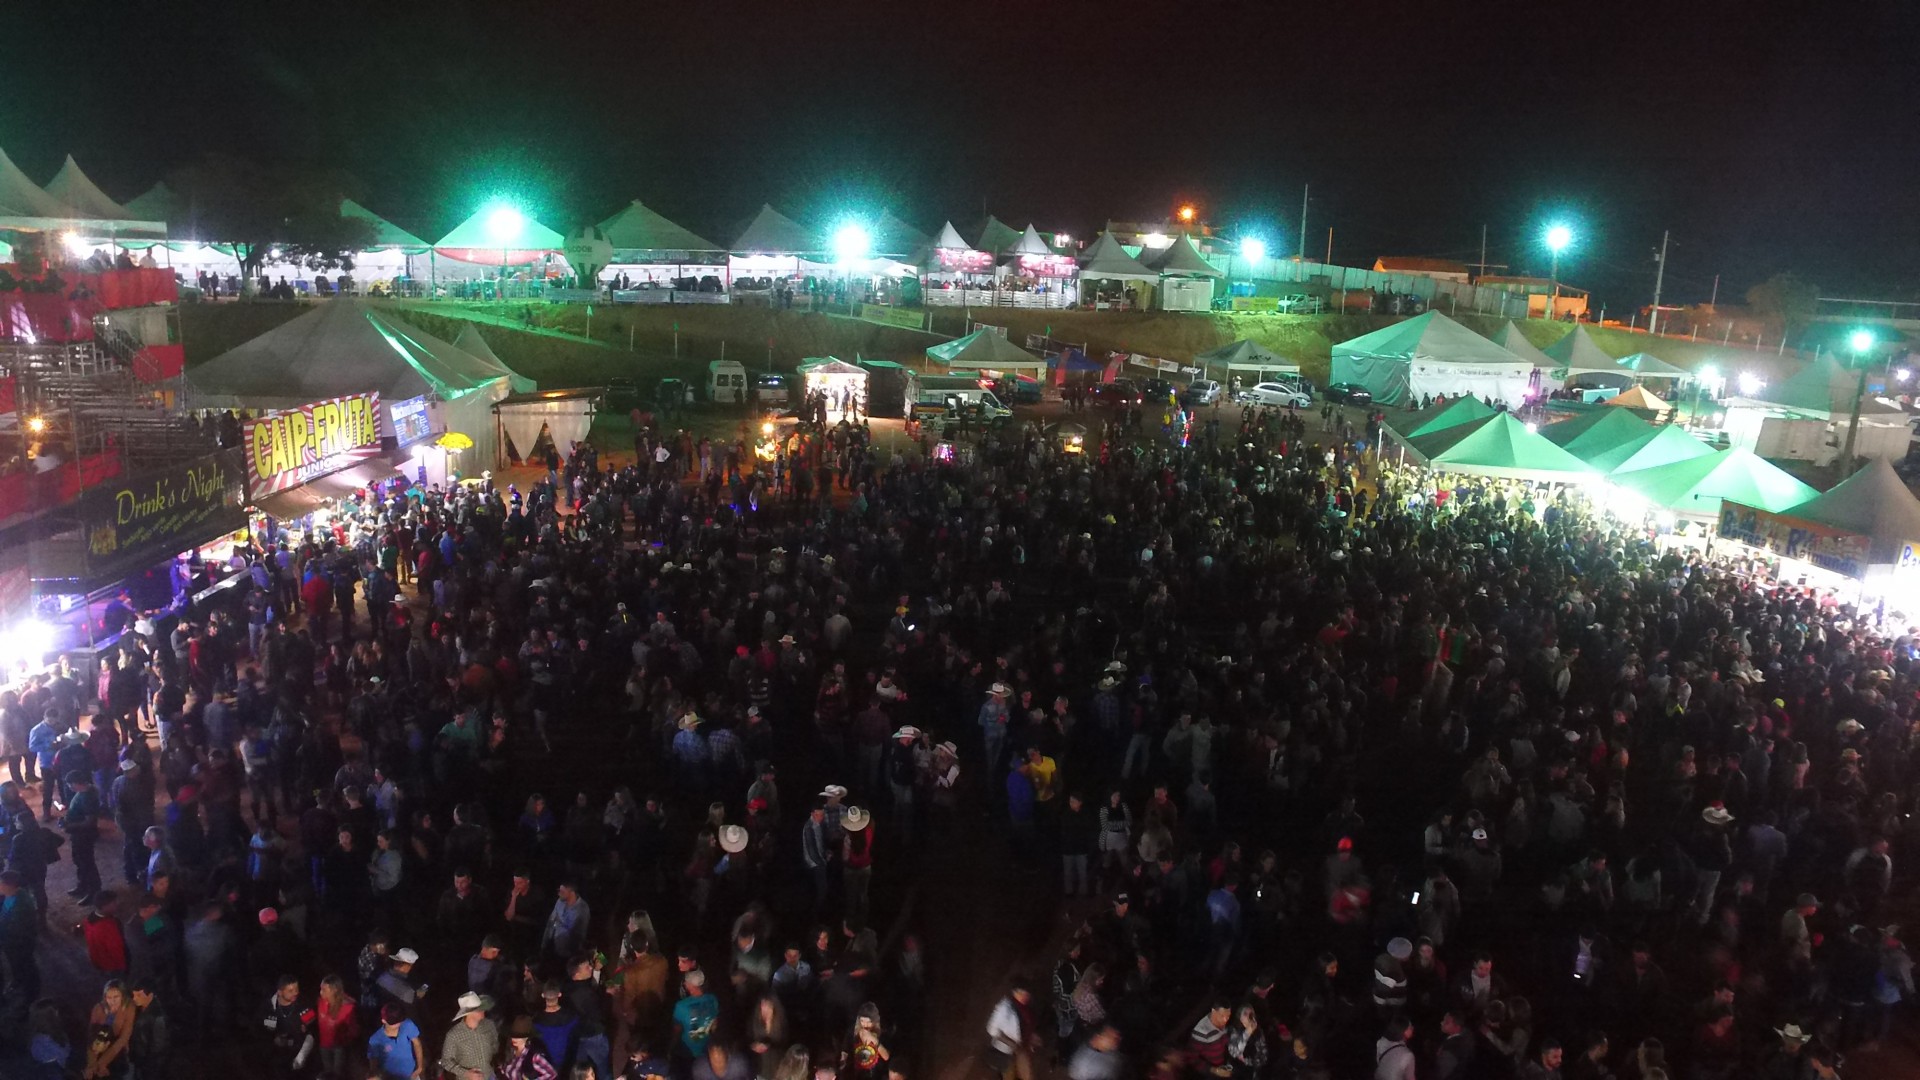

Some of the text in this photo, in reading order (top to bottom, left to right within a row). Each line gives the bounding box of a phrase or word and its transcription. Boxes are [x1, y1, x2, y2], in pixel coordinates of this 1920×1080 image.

[253, 396, 376, 480] CAIP-FRUTA
[115, 477, 175, 526] Drink's
[181, 463, 225, 503] Night
[1902, 544, 1920, 567] Ba
